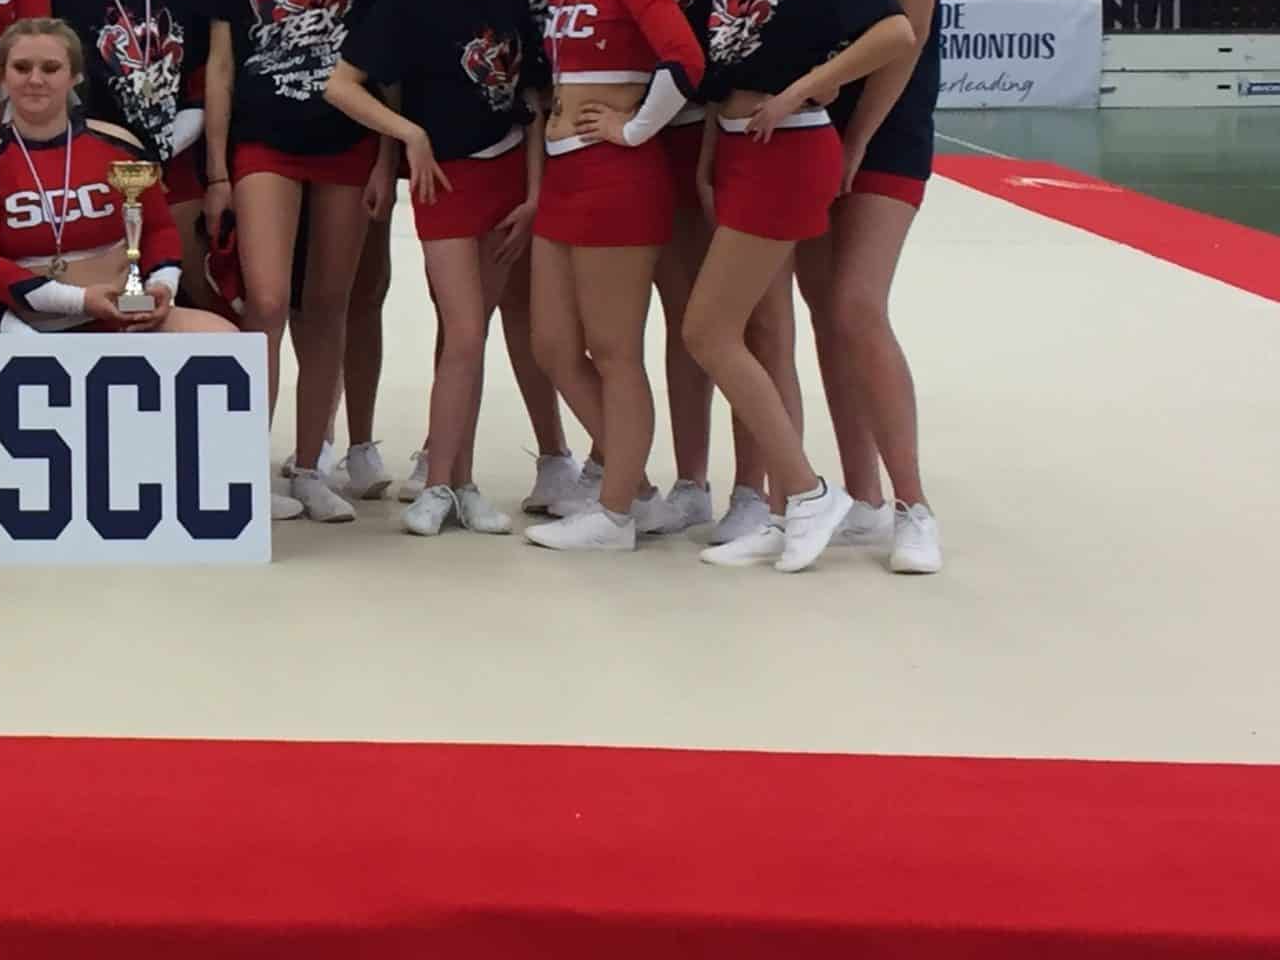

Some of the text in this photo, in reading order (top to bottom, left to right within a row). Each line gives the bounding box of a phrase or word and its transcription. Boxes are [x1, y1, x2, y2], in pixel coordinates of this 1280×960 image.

[255, 1, 336, 48] T-REX
[940, 33, 1056, 60] RMONTOIS
[940, 72, 1035, 102] erleading
[5, 183, 115, 229] SCC
